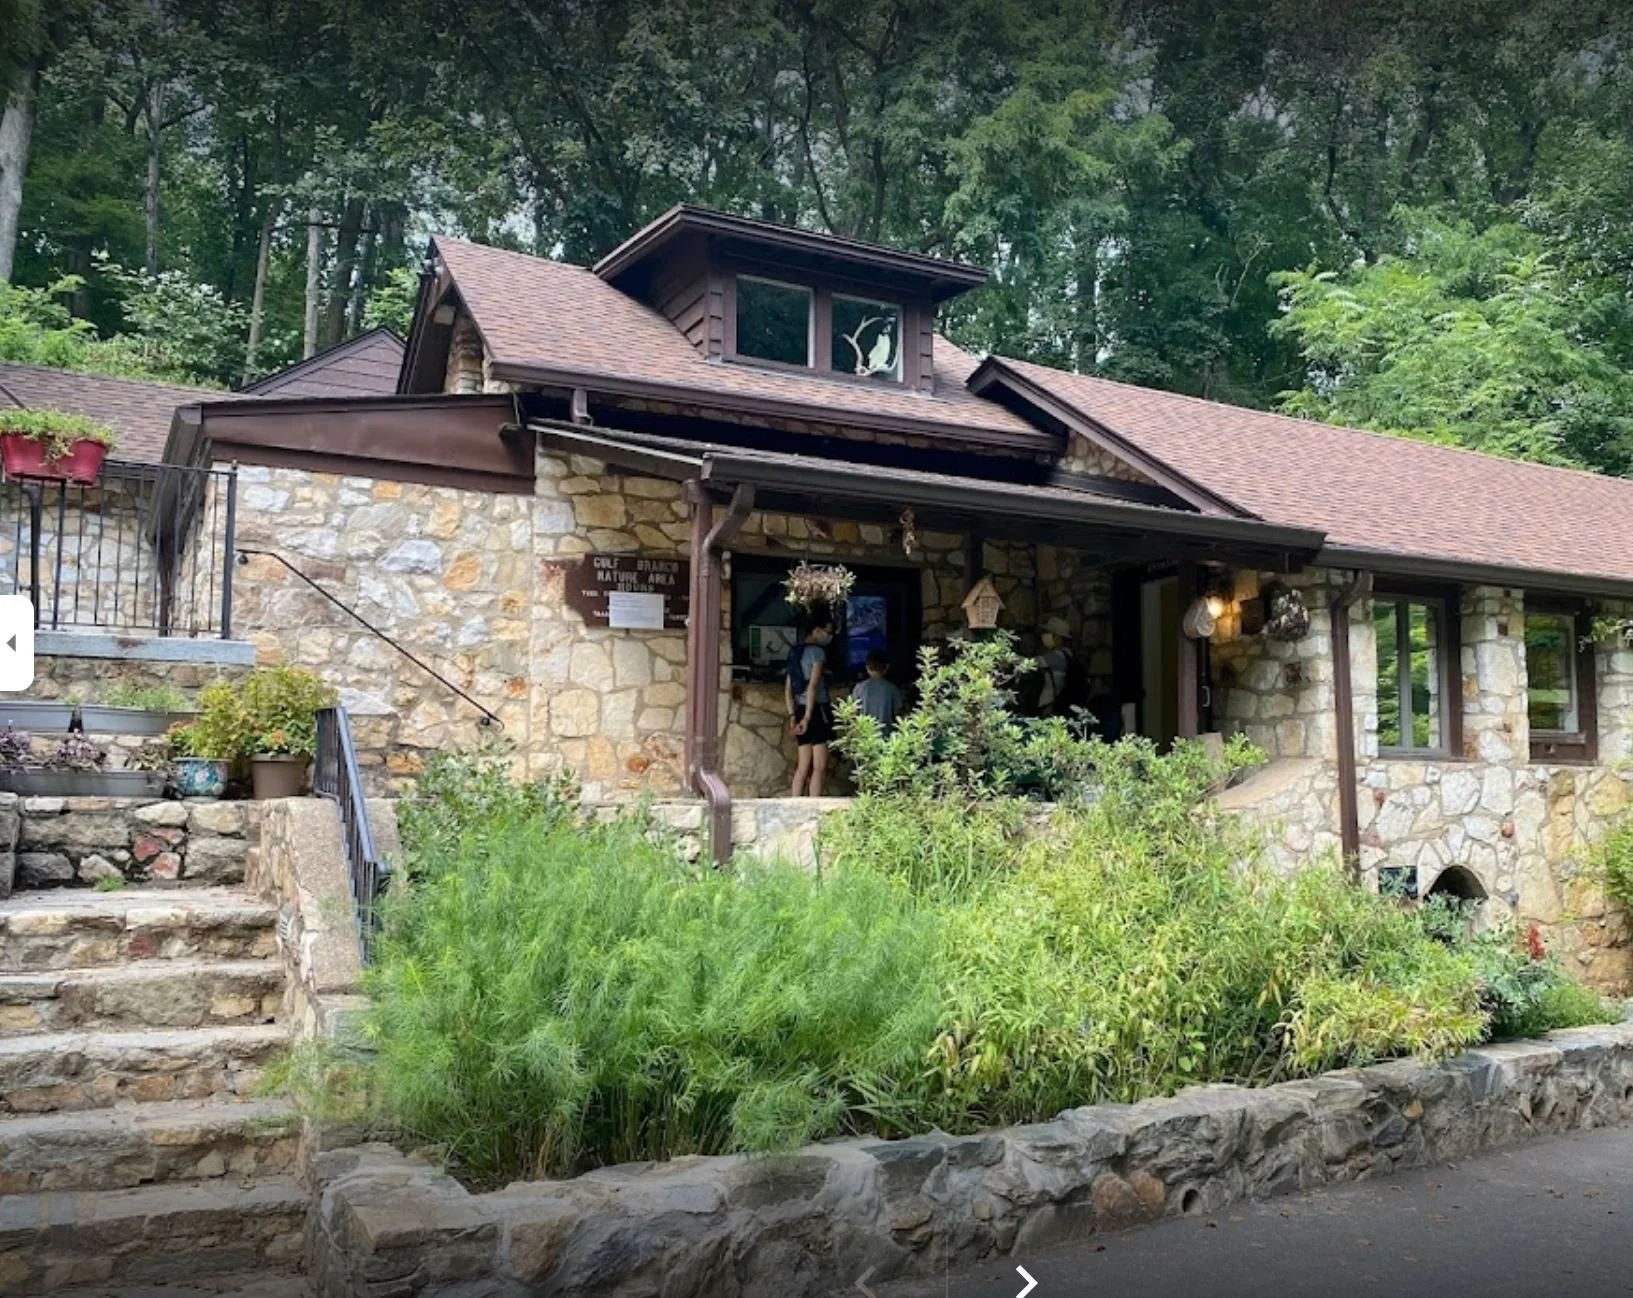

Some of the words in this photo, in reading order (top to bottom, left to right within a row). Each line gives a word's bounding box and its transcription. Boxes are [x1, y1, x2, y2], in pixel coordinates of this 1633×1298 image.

[593, 556, 620, 569] GULF
[597, 569, 638, 583] NATURE
[648, 573, 676, 585] AREA
